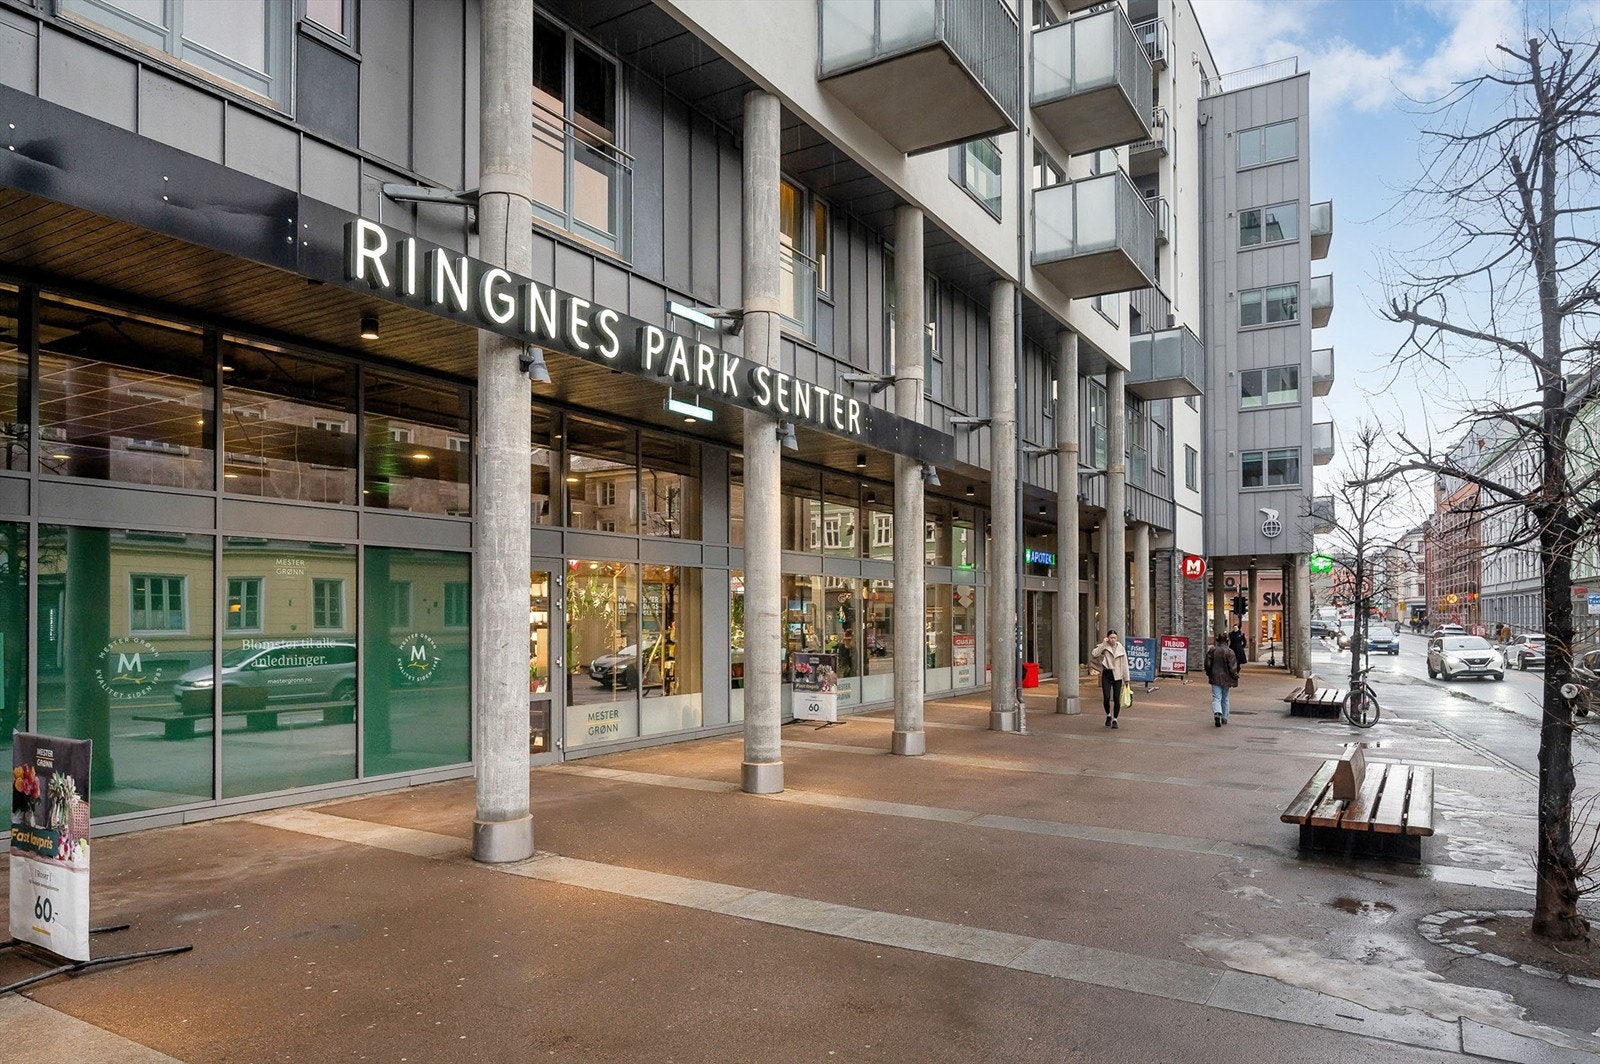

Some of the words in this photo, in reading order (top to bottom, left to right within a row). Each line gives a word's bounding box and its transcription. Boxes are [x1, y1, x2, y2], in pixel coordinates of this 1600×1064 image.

[349, 217, 620, 359] RINGNES
[641, 325, 739, 397] PARK
[752, 366, 861, 435] SENTER
[275, 558, 305, 567] MESTER
[1031, 551, 1052, 565] APOTEK
[275, 567, 305, 576] GRØNN
[1262, 591, 1283, 607] SK
[99, 637, 130, 659] MESTER
[241, 639, 298, 651] Blomster
[301, 638, 313, 649] til
[316, 637, 337, 649] alle
[1164, 640, 1185, 648] TILBUD
[410, 645, 426, 661] M
[117, 652, 142, 673] M
[251, 655, 328, 668] anledninger.
[95, 669, 124, 699] KVALITET
[127, 685, 153, 700] SIDEN
[588, 709, 619, 721] MESTER
[588, 724, 619, 736] GRØNN
[36, 747, 54, 758] MESTER
[36, 759, 54, 769] GRØNN
[11, 828, 30, 844] Fast
[30, 831, 53, 850] lavpris
